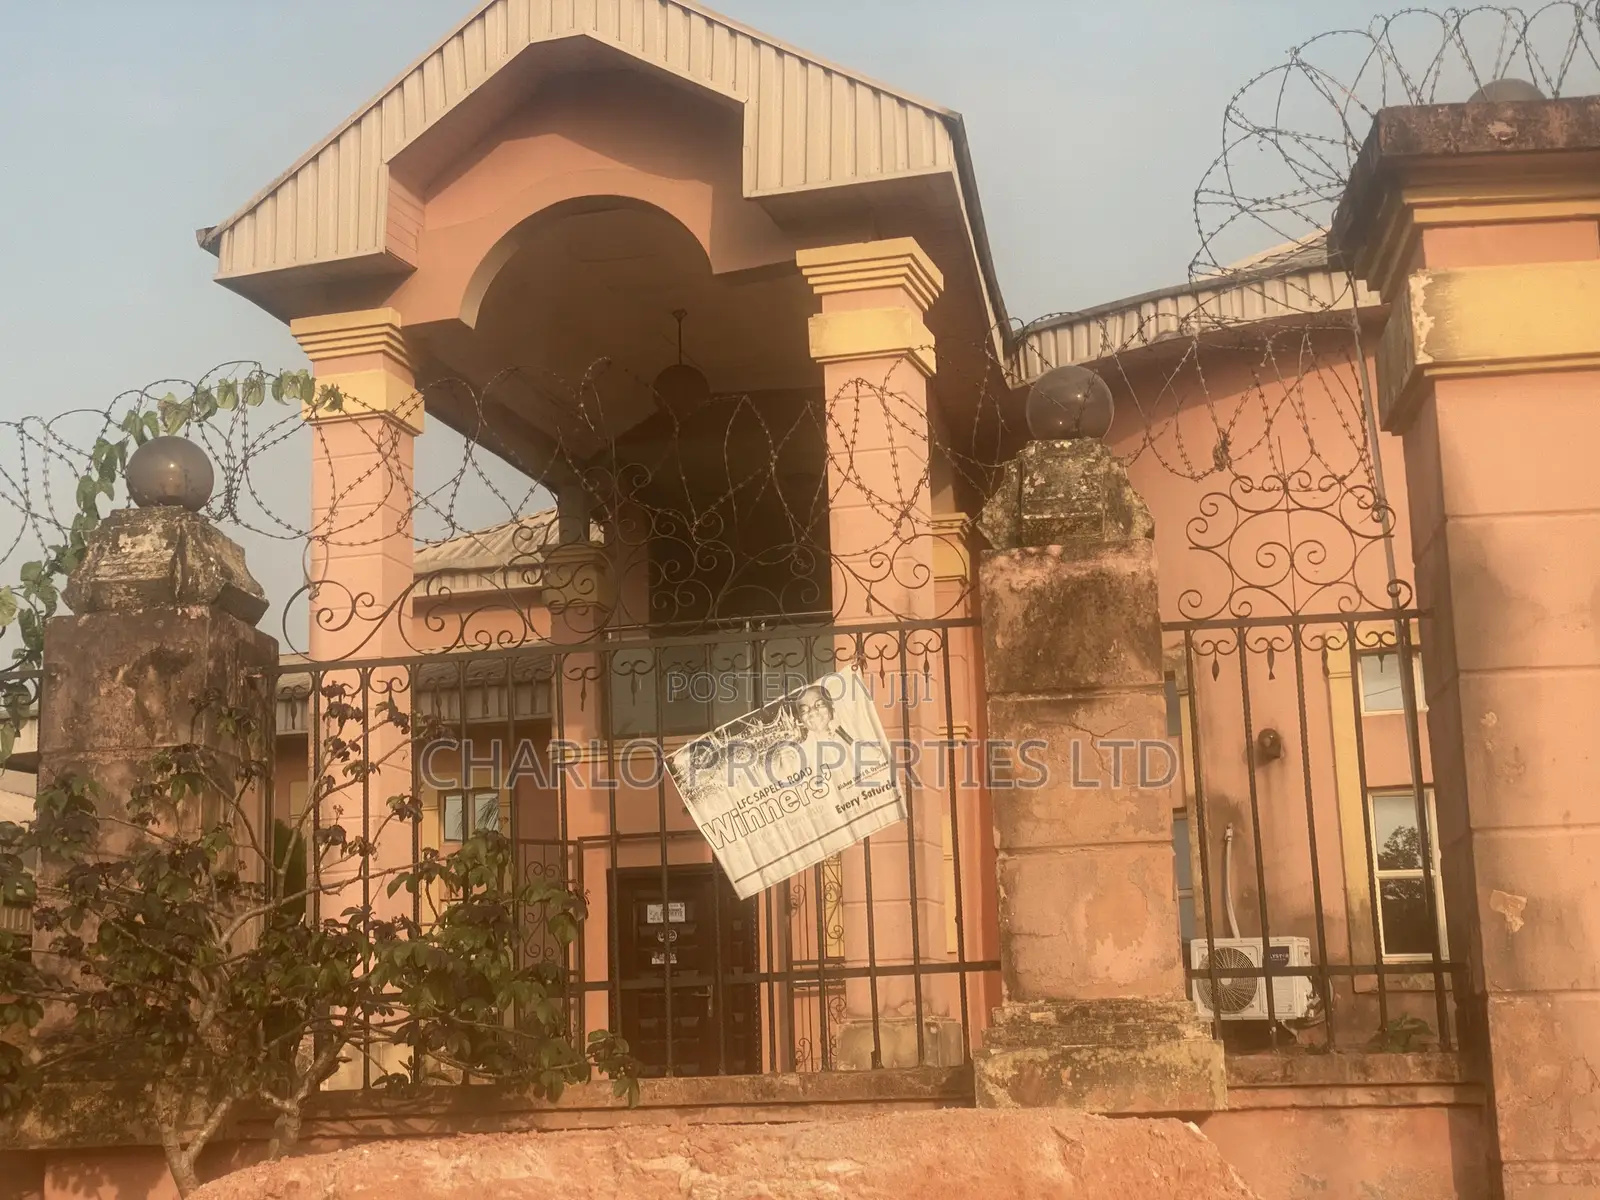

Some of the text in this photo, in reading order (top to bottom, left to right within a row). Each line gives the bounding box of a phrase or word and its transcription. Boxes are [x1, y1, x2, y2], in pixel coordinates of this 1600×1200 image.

[737, 767, 812, 810] LFC SAPELE ROAD
[835, 796, 860, 814] Every
